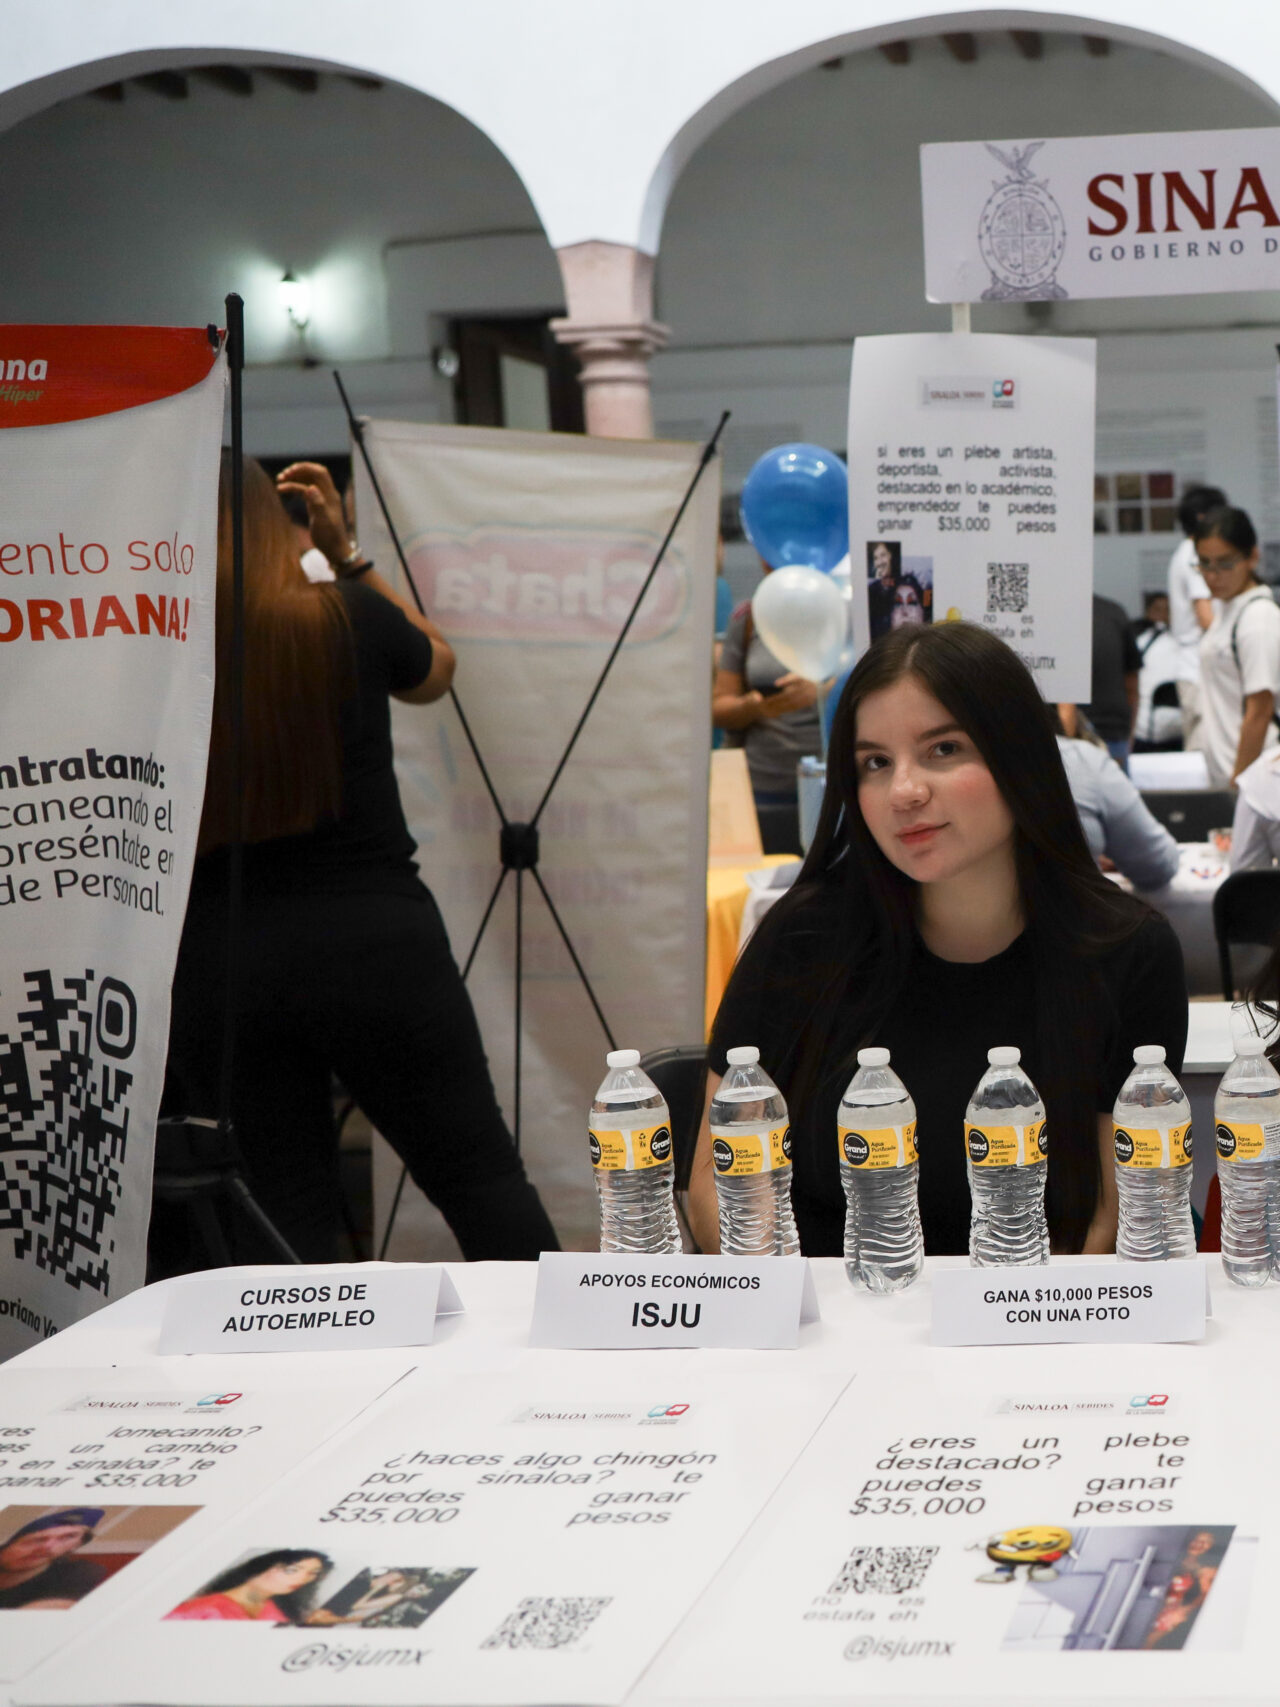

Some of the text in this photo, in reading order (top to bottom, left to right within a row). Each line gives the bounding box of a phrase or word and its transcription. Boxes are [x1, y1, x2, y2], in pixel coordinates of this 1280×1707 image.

[1089, 240, 1245, 262] GOBIERNO
[0, 359, 48, 381] na
[877, 446, 887, 458] si
[898, 448, 926, 458] eres
[937, 447, 953, 458] un
[964, 446, 1001, 461] plebe
[877, 482, 942, 494] destacado
[945, 485, 962, 495] en
[965, 482, 977, 495] lo
[877, 500, 1057, 516] emprendedor te puedes
[877, 516, 1057, 534] ganar $35,000 pesos
[0, 531, 194, 576] ento solo
[154, 799, 174, 834] el
[844, 1143, 868, 1154] Grand
[579, 1272, 761, 1290] APOYOS ECONÓMICOS
[240, 1283, 367, 1306] CURSOS DE
[983, 1285, 1153, 1304] GANA $10,000 PESOS
[222, 1308, 376, 1333] AUTOEMPLEO
[631, 1302, 701, 1329] ISJU
[1006, 1306, 1130, 1323] CON UNA FOTO
[532, 1412, 588, 1420] SINALOA
[1013, 1403, 1070, 1411] SINALOA
[106, 1425, 262, 1438] lomecanito?
[69, 1442, 104, 1454] un
[145, 1441, 239, 1454] cambio
[886, 1432, 1191, 1454] ¿eres un plebe
[19, 1459, 55, 1470] en
[66, 1457, 181, 1471] sinaloa?
[189, 1458, 216, 1470] te
[384, 1449, 717, 1471] ¿haces algo chingón
[875, 1452, 1185, 1471] destacado? te
[84, 1473, 197, 1488] $35,000
[362, 1469, 703, 1488] por sinaloa? te
[860, 1473, 1182, 1496] puedes ganar
[341, 1488, 691, 1509] puedes ganar
[849, 1496, 1174, 1518] $35,000 pesos
[319, 1506, 672, 1529] $35,000 pesos
[811, 1595, 925, 1607] no es
[803, 1607, 918, 1622] estafa eh
[843, 1633, 957, 1663] @isjumx
[281, 1643, 432, 1674] @isjumx
